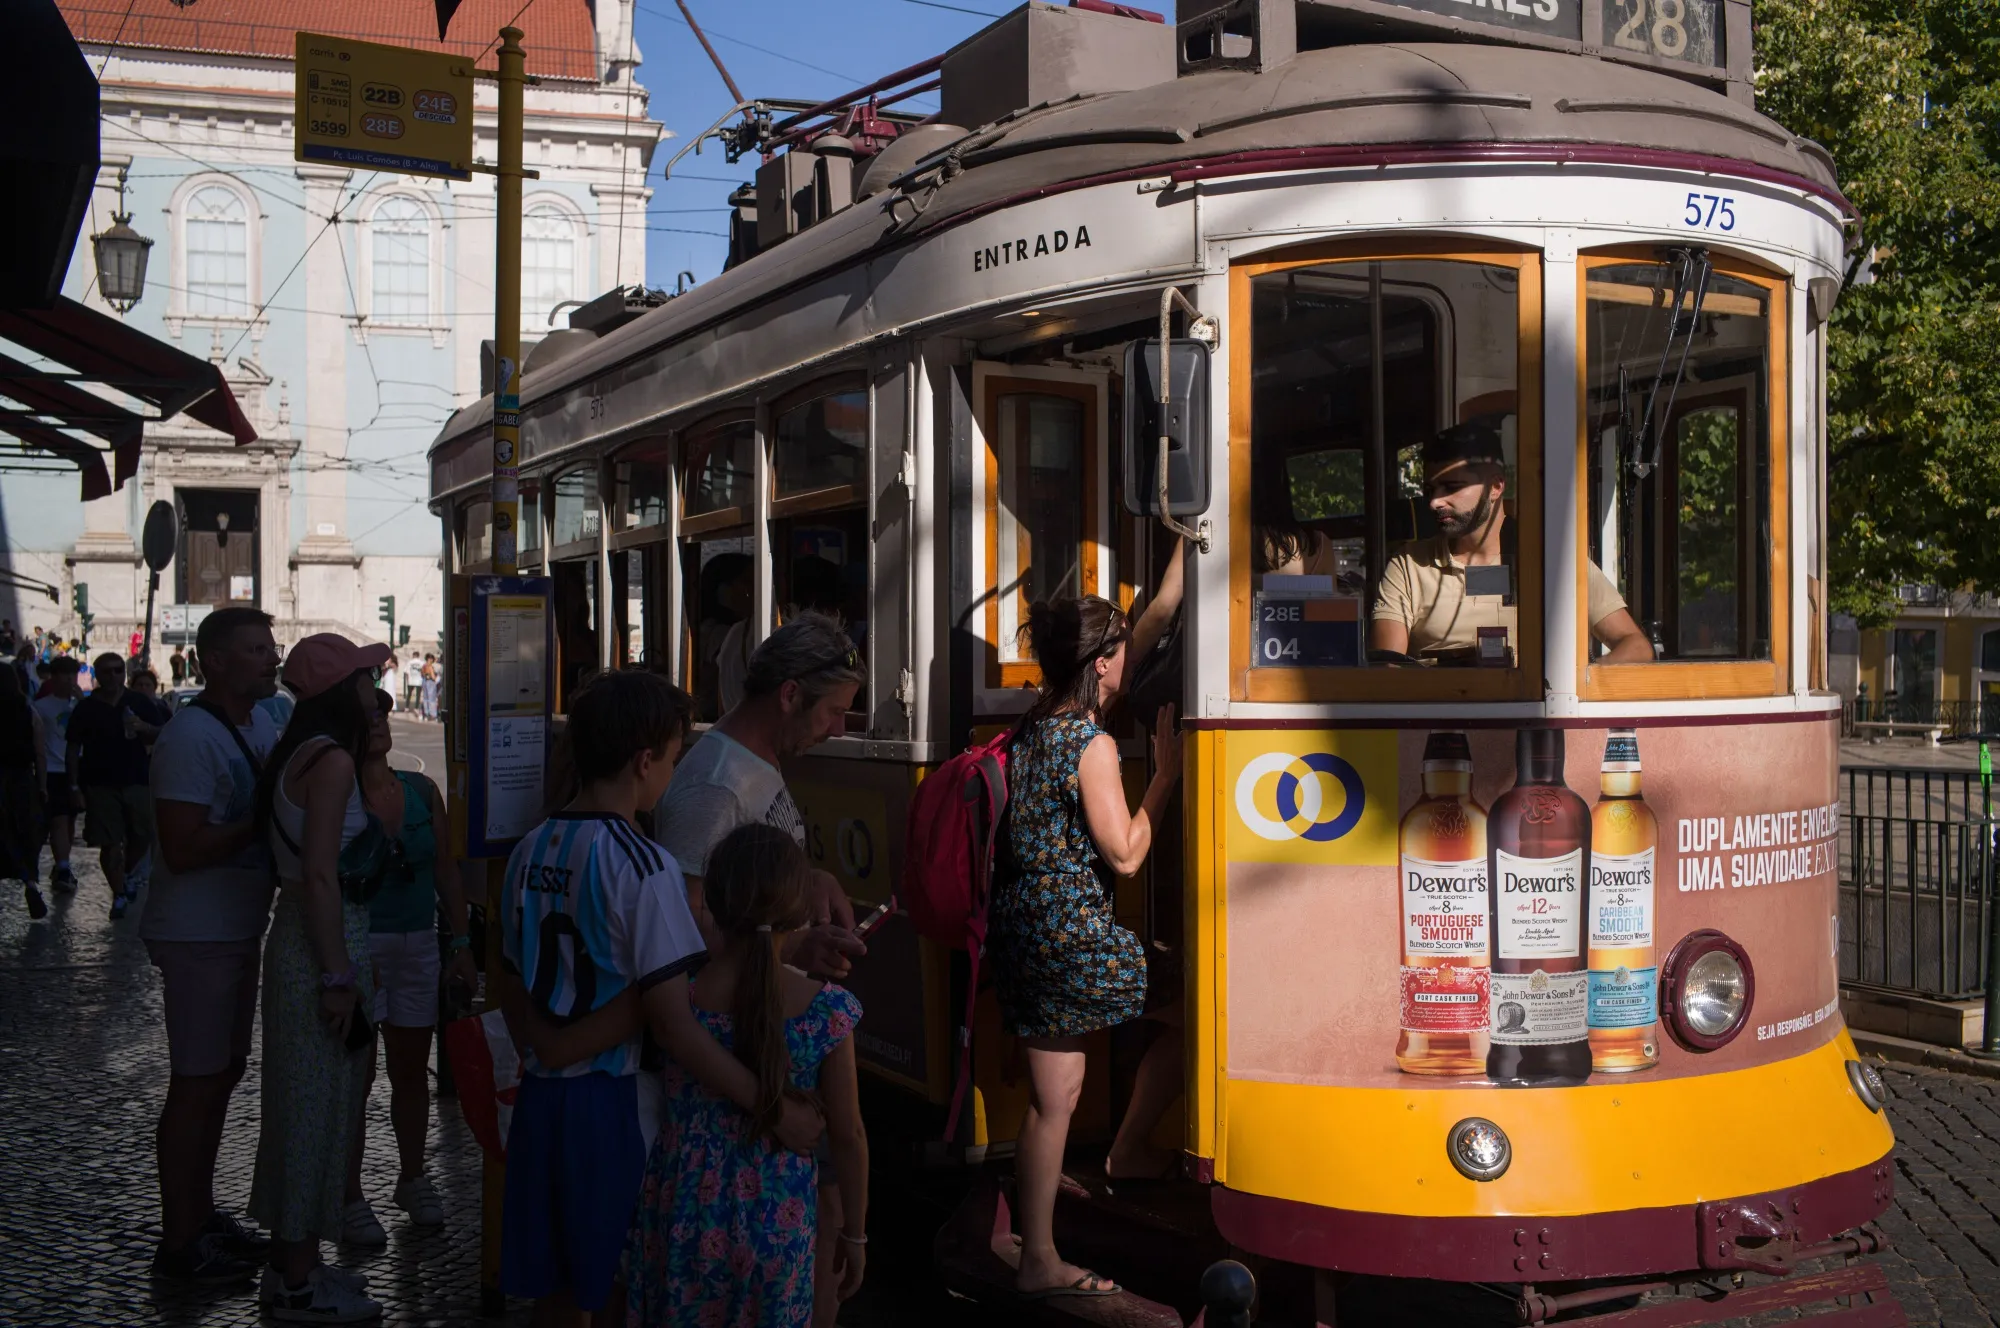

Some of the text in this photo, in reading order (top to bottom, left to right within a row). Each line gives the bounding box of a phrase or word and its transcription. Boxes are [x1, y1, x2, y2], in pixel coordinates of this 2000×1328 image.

[1614, 0, 1688, 56] 28
[309, 48, 335, 58] carris
[330, 78, 349, 88] SMS
[310, 95, 348, 108] C 10512
[365, 87, 400, 105] 22B
[418, 94, 452, 112] 24E
[418, 112, 452, 122] DESCIDA
[311, 120, 348, 136] 3599
[366, 118, 400, 135] 28E
[1684, 192, 1735, 231] 575
[974, 225, 1091, 272] ENTRADA
[591, 396, 604, 420] 575
[1264, 606, 1300, 622] 28E
[1264, 637, 1302, 660] 04
[1678, 811, 1798, 853] DUPLAMENTE
[1591, 866, 1650, 887] Dewar's
[1678, 856, 1725, 892] UMA
[1731, 845, 1812, 888] SUAVIDADE
[1408, 871, 1487, 893] Dewar's
[1504, 872, 1576, 893] Dewar's
[1441, 900, 1451, 914] 8
[1532, 898, 1548, 914] 12
[1617, 893, 1625, 906] 8
[1599, 905, 1644, 918] CARIBBEAN
[1410, 914, 1484, 928] PORTUGUESE
[1599, 917, 1644, 933] SMOOTH
[1421, 927, 1474, 941] SMOOTH
[1502, 991, 1519, 1000] John
[1520, 990, 1545, 1000] Dewar
[1545, 991, 1551, 999] &
[1551, 989, 1569, 999] Sons
[1592, 983, 1607, 992] John
[1607, 983, 1628, 992] Dewar
[1757, 1023, 1776, 1041] SEJA
